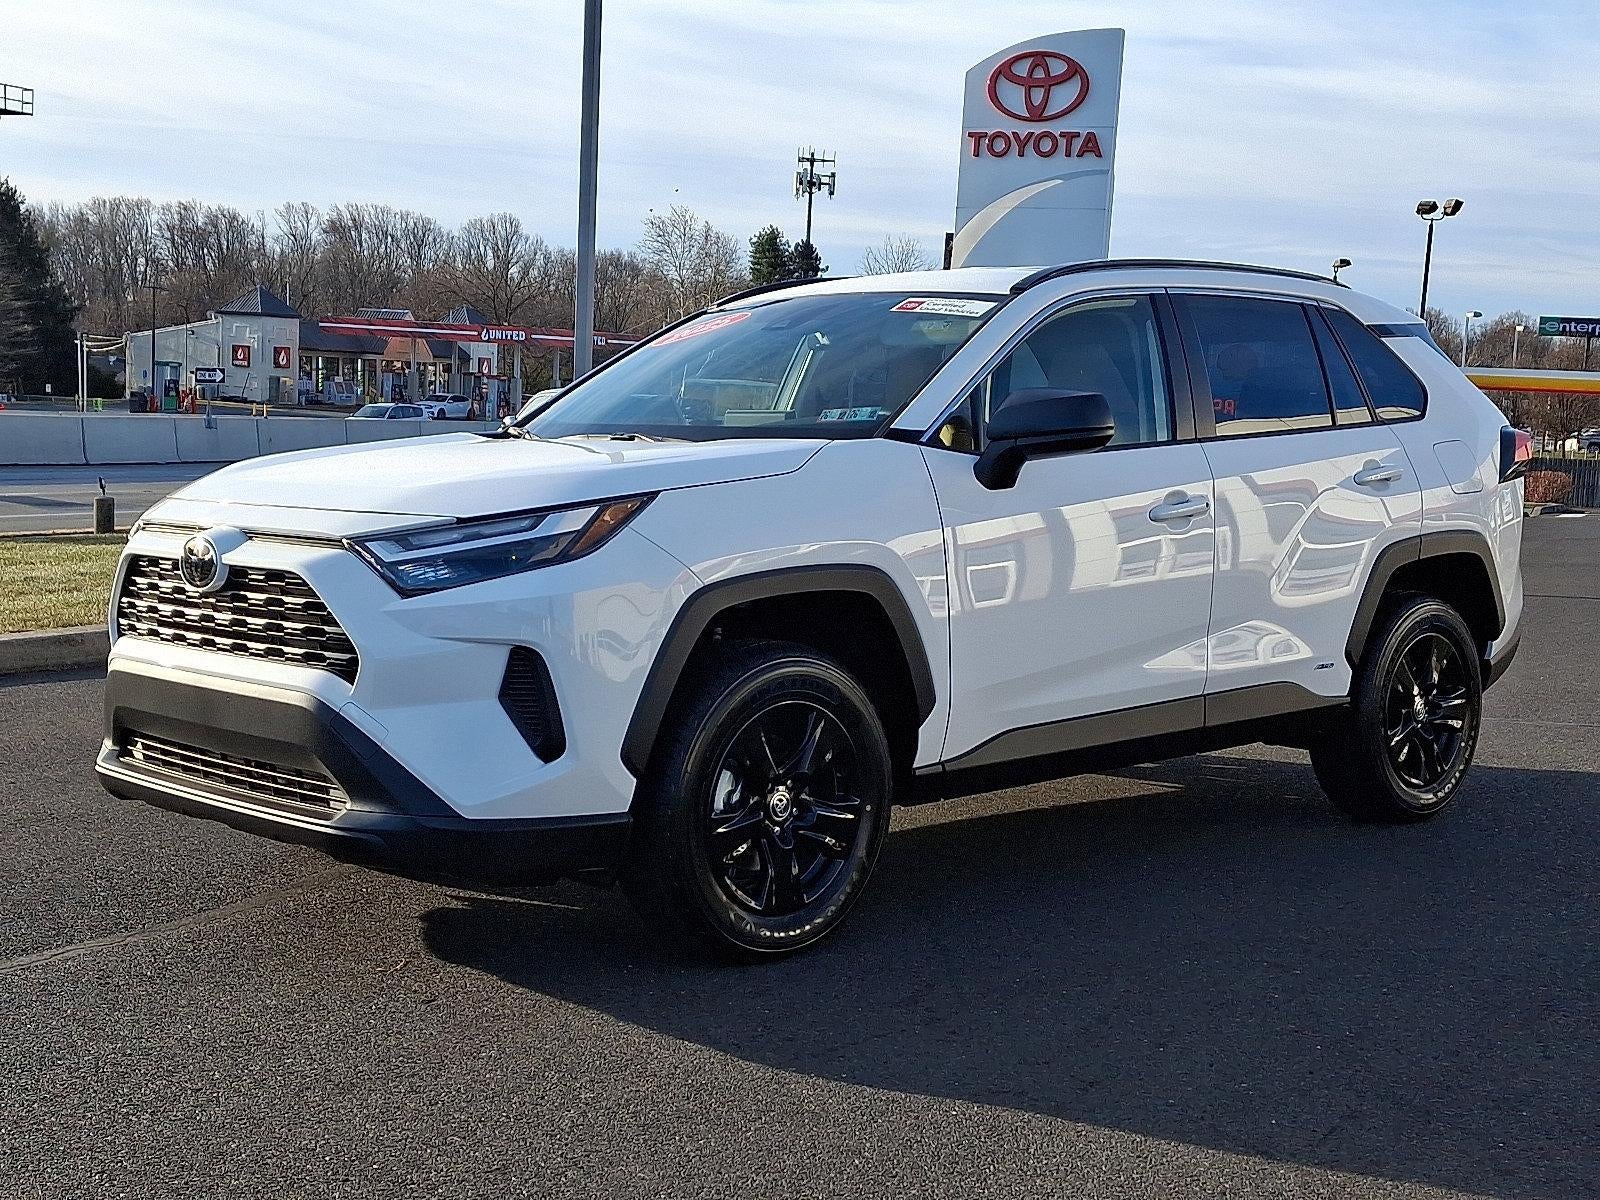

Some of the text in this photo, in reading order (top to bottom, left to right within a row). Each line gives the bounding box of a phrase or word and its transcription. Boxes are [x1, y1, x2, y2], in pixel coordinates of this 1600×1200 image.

[967, 130, 1103, 159] TOYOTA
[489, 329, 526, 341] UNITED
[593, 336, 606, 346] TED
